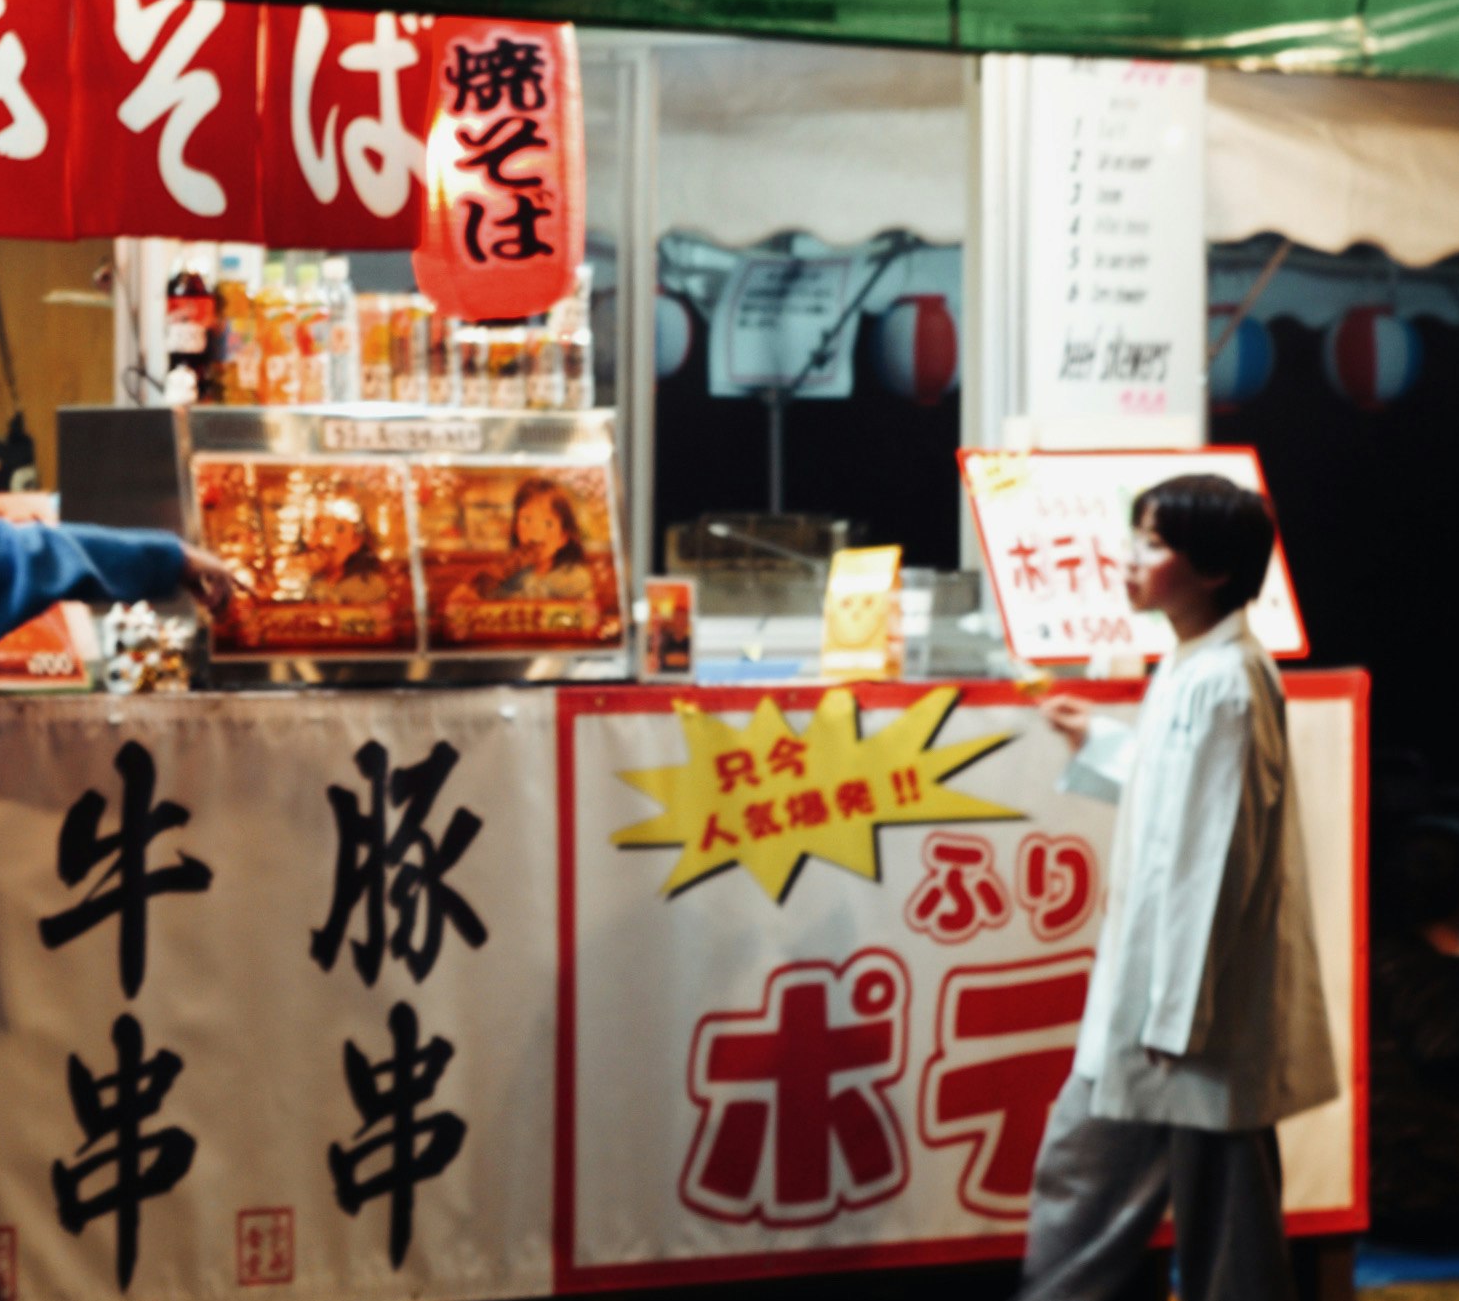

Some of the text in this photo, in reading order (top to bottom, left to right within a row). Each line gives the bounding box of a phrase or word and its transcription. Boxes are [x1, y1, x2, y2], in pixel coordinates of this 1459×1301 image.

[444, 34, 558, 268] 焼そば
[714, 737, 808, 795] 只今
[37, 739, 215, 1296] 牛串
[309, 738, 489, 1272] 豚串
